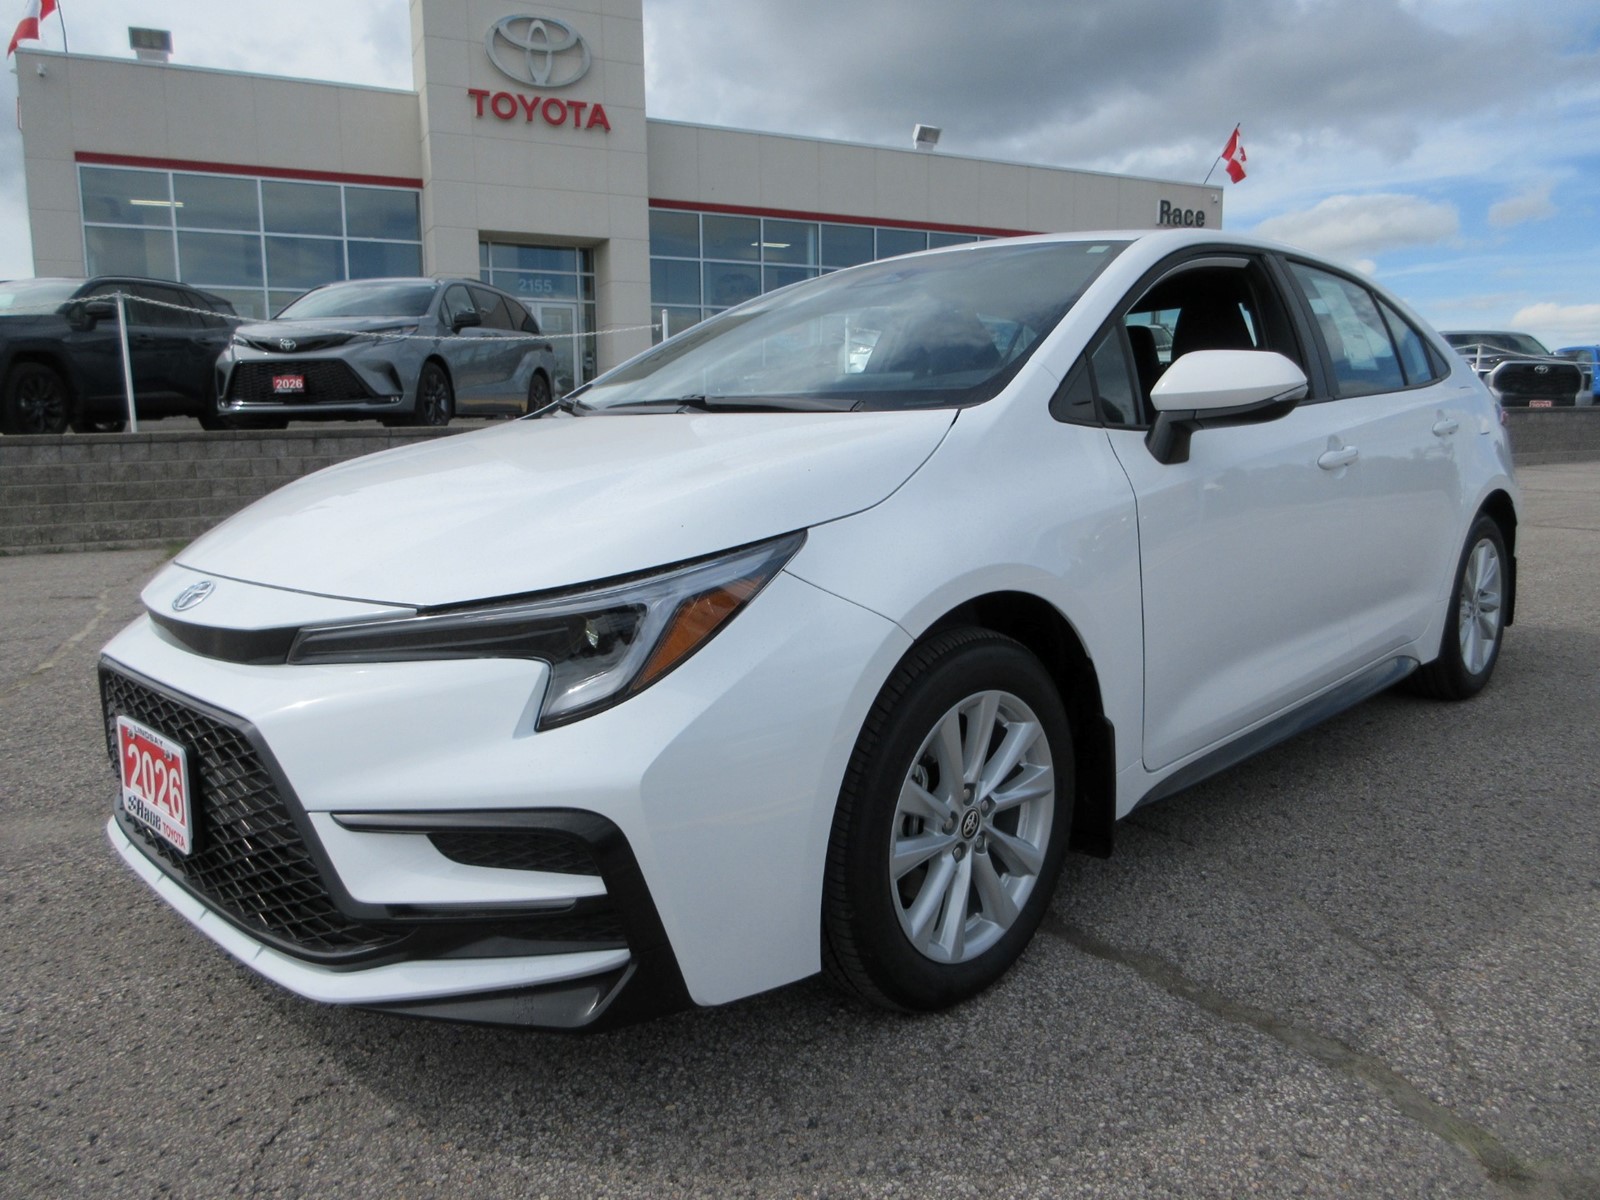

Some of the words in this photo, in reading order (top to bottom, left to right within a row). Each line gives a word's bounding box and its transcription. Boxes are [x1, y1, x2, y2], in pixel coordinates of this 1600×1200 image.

[468, 89, 611, 132] TOYOTA
[1156, 200, 1205, 227] Race
[519, 279, 552, 293] 2155
[275, 378, 303, 389] 2026
[133, 725, 164, 747] LINDSAY
[128, 743, 182, 822] 2026
[137, 798, 161, 832] Race
[162, 821, 186, 850] TOYOTA
